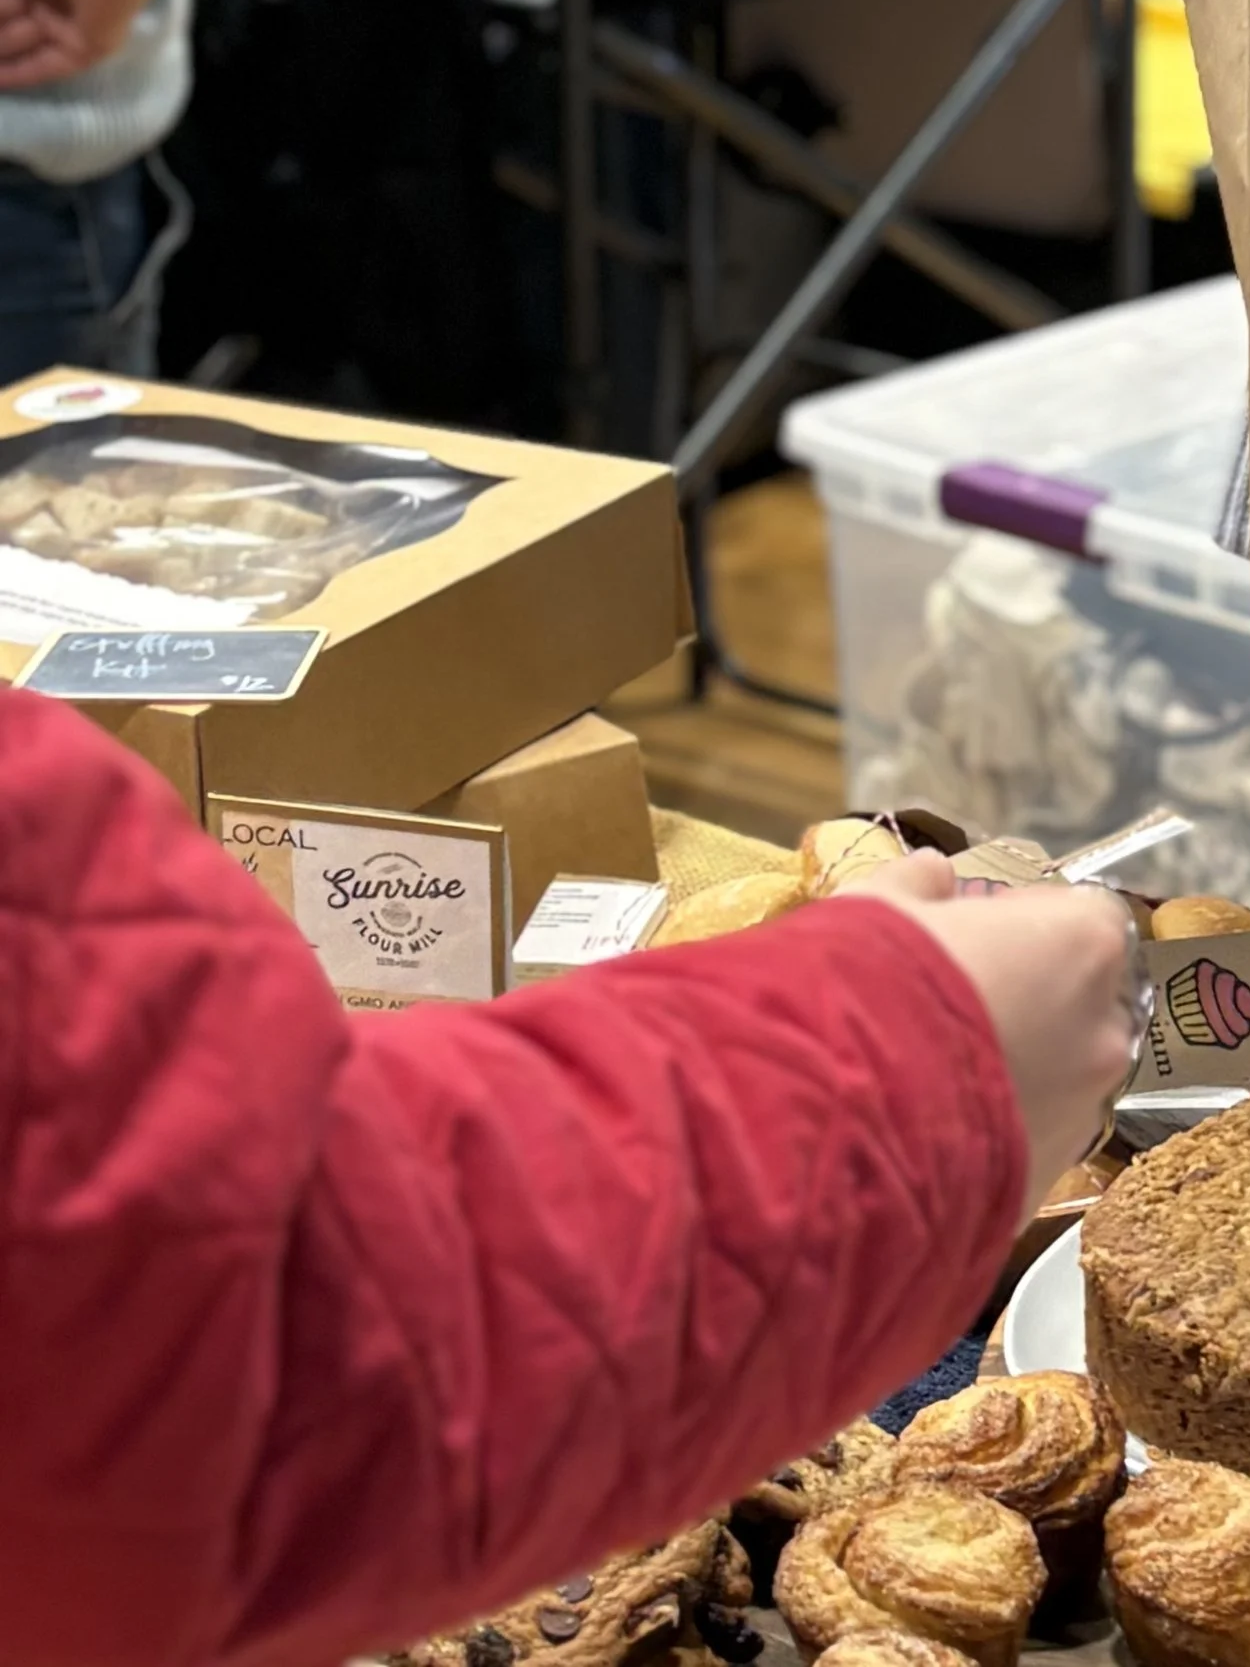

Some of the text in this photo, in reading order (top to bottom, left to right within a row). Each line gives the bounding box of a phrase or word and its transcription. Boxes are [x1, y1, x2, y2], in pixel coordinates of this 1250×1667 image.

[322, 867, 466, 910] Sunrise
[351, 916, 403, 956] FLOUR
[409, 926, 444, 955] MILL
